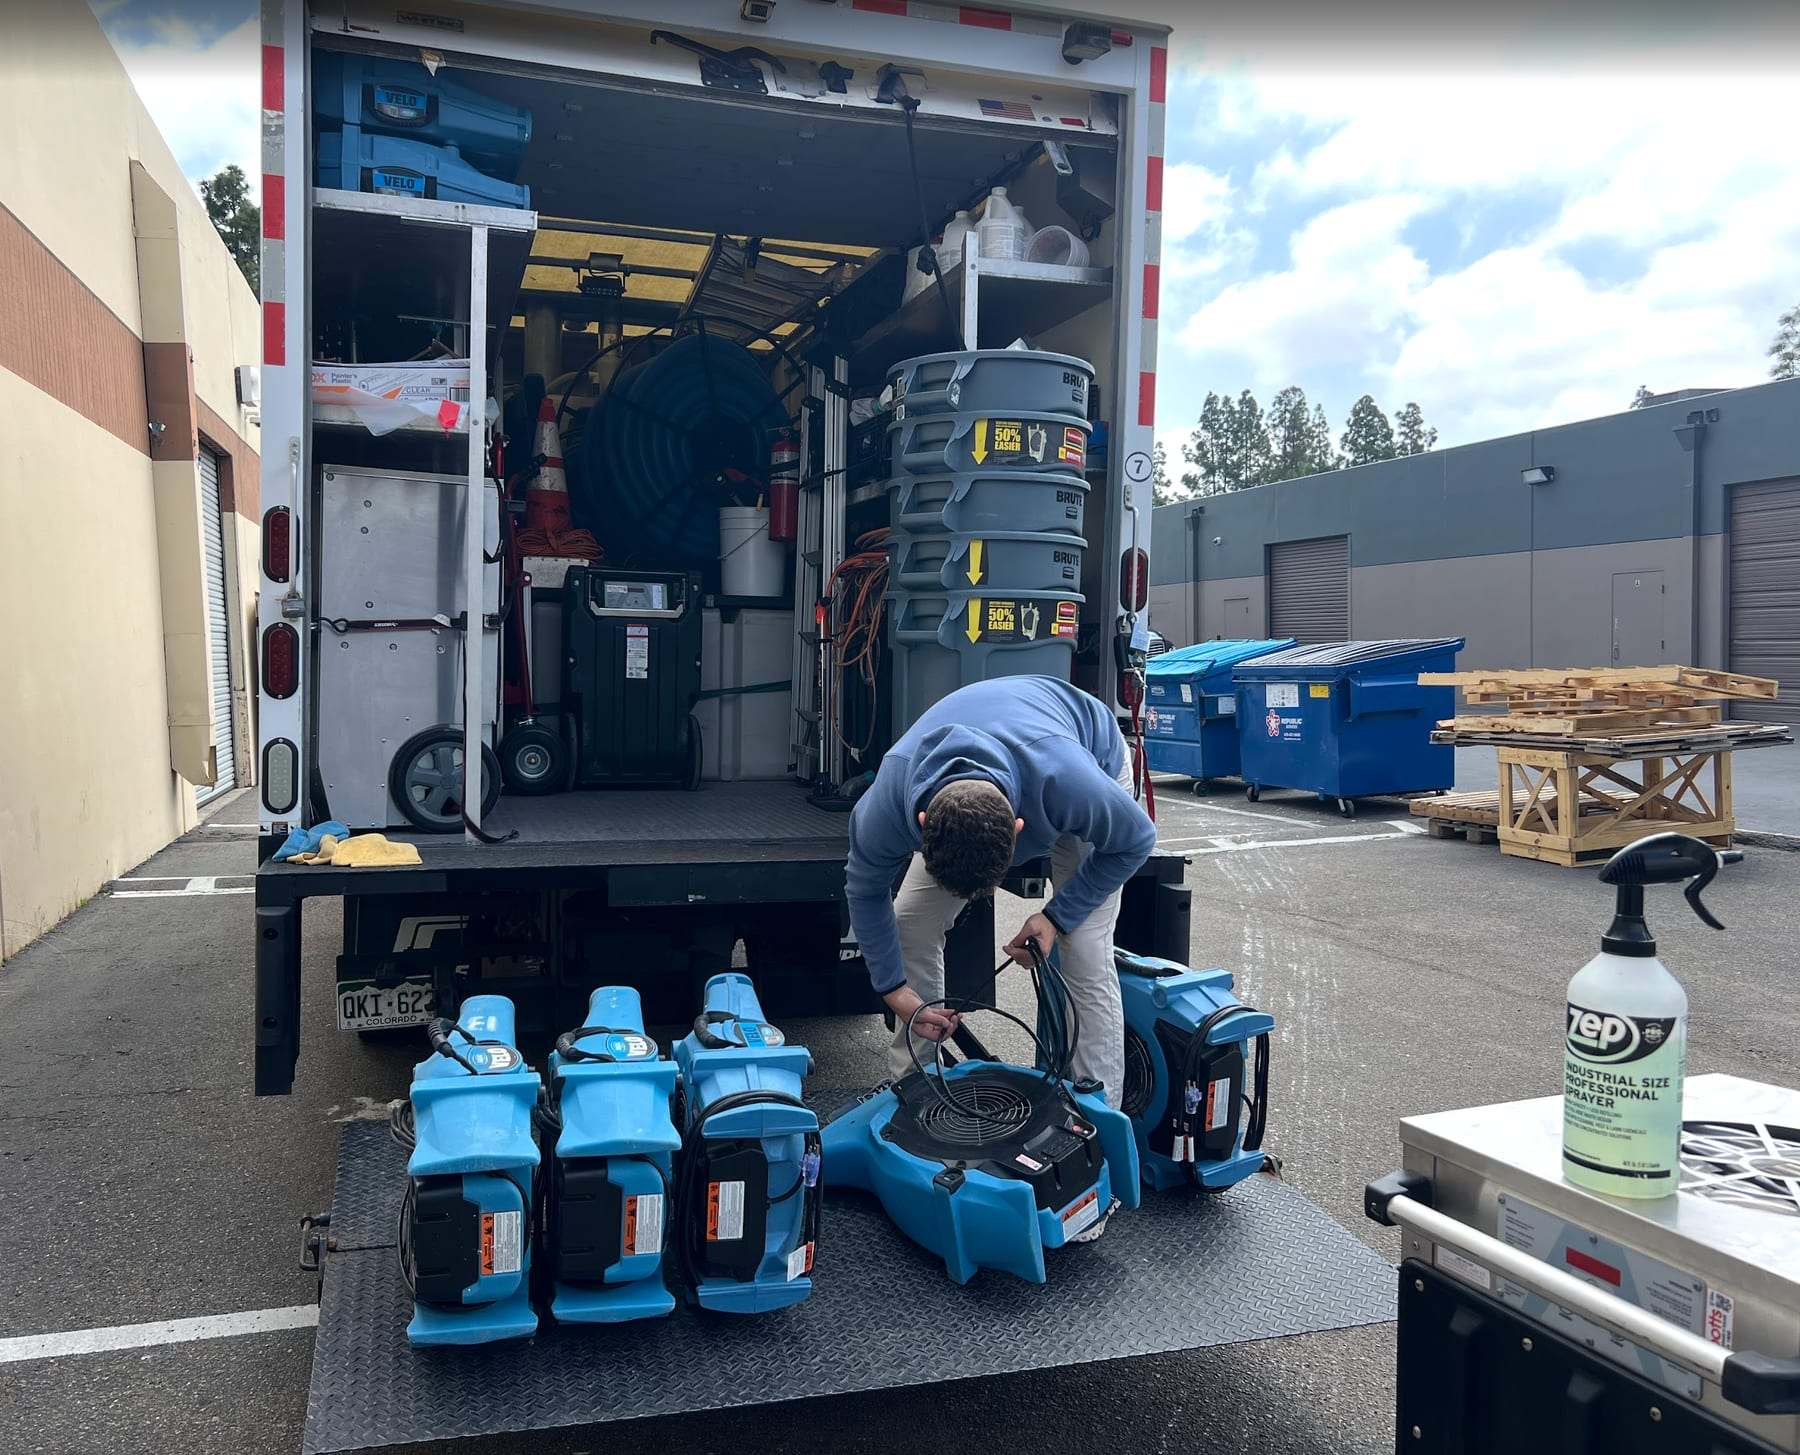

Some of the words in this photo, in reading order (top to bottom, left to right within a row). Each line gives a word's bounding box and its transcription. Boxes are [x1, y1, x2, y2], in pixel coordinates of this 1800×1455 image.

[384, 91, 416, 108] VELO
[384, 174, 415, 189] VELO
[995, 428, 1021, 442] 50%
[994, 441, 1021, 452] EASIER
[1134, 459, 1143, 474] 7
[988, 608, 1014, 622] 50%
[988, 621, 1014, 631] EASIER
[366, 1015, 417, 1026] COLORADO
[1566, 1072, 1659, 1101] PROFESSIONAL
[1641, 1077, 1671, 1088] SIZE
[1565, 1084, 1615, 1108] SPRAYER
